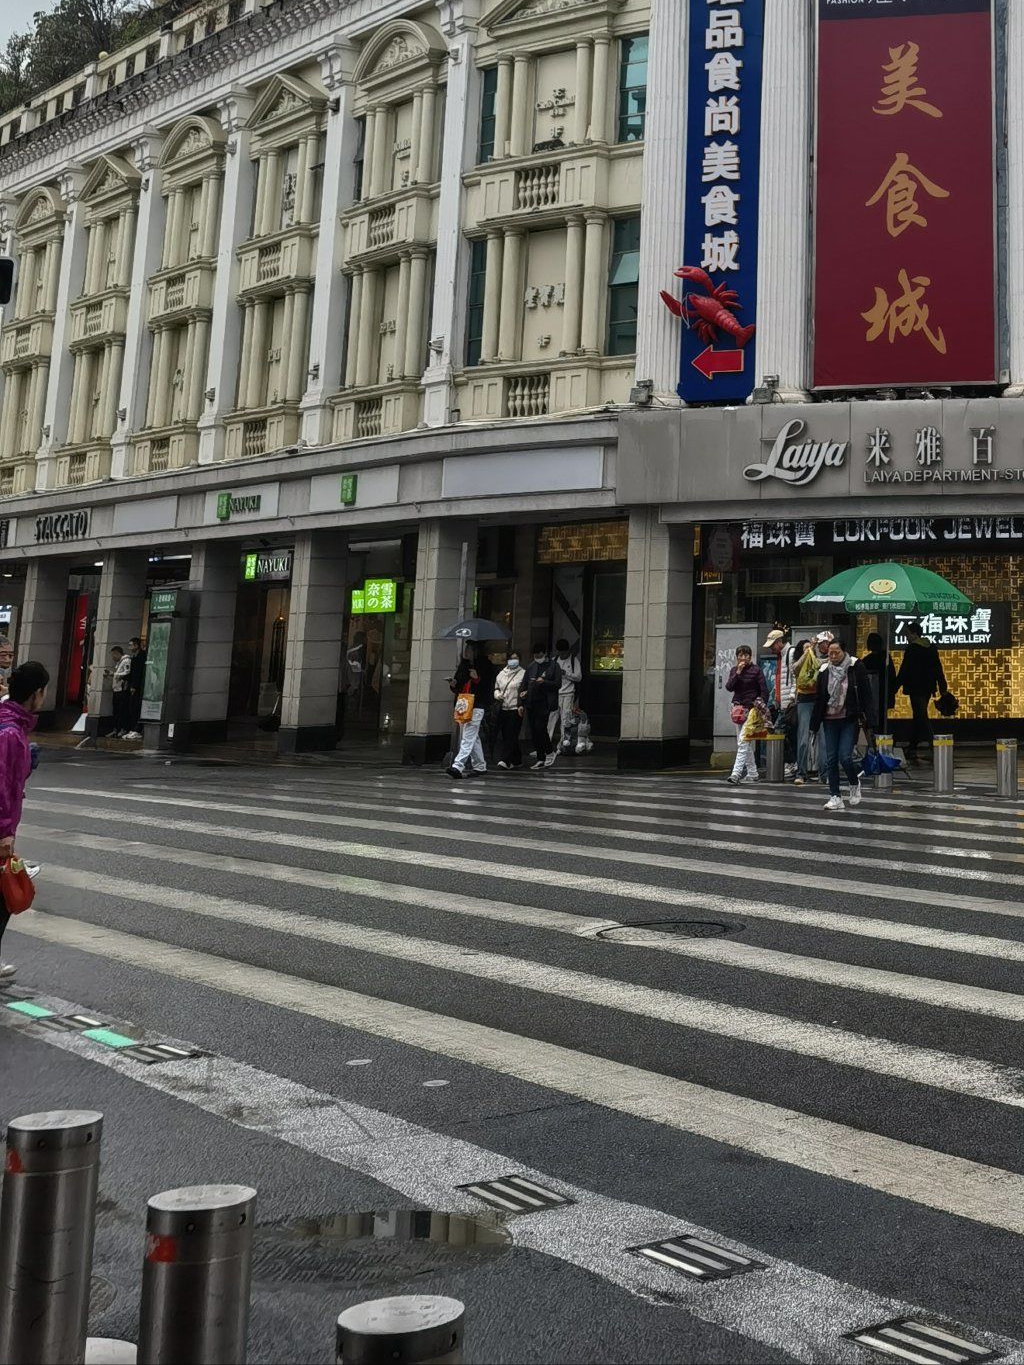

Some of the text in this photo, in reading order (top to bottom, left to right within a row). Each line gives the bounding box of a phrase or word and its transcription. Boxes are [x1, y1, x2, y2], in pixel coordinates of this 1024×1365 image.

[860, 40, 951, 354] 美食城
[742, 418, 849, 485] Laiya
[863, 470, 901, 483] LAIYA
[34, 511, 89, 543] STACCATO
[833, 518, 937, 542] LUKFOOK
[257, 557, 288, 574] NAYUKI
[938, 634, 992, 644] JEWELLERY
